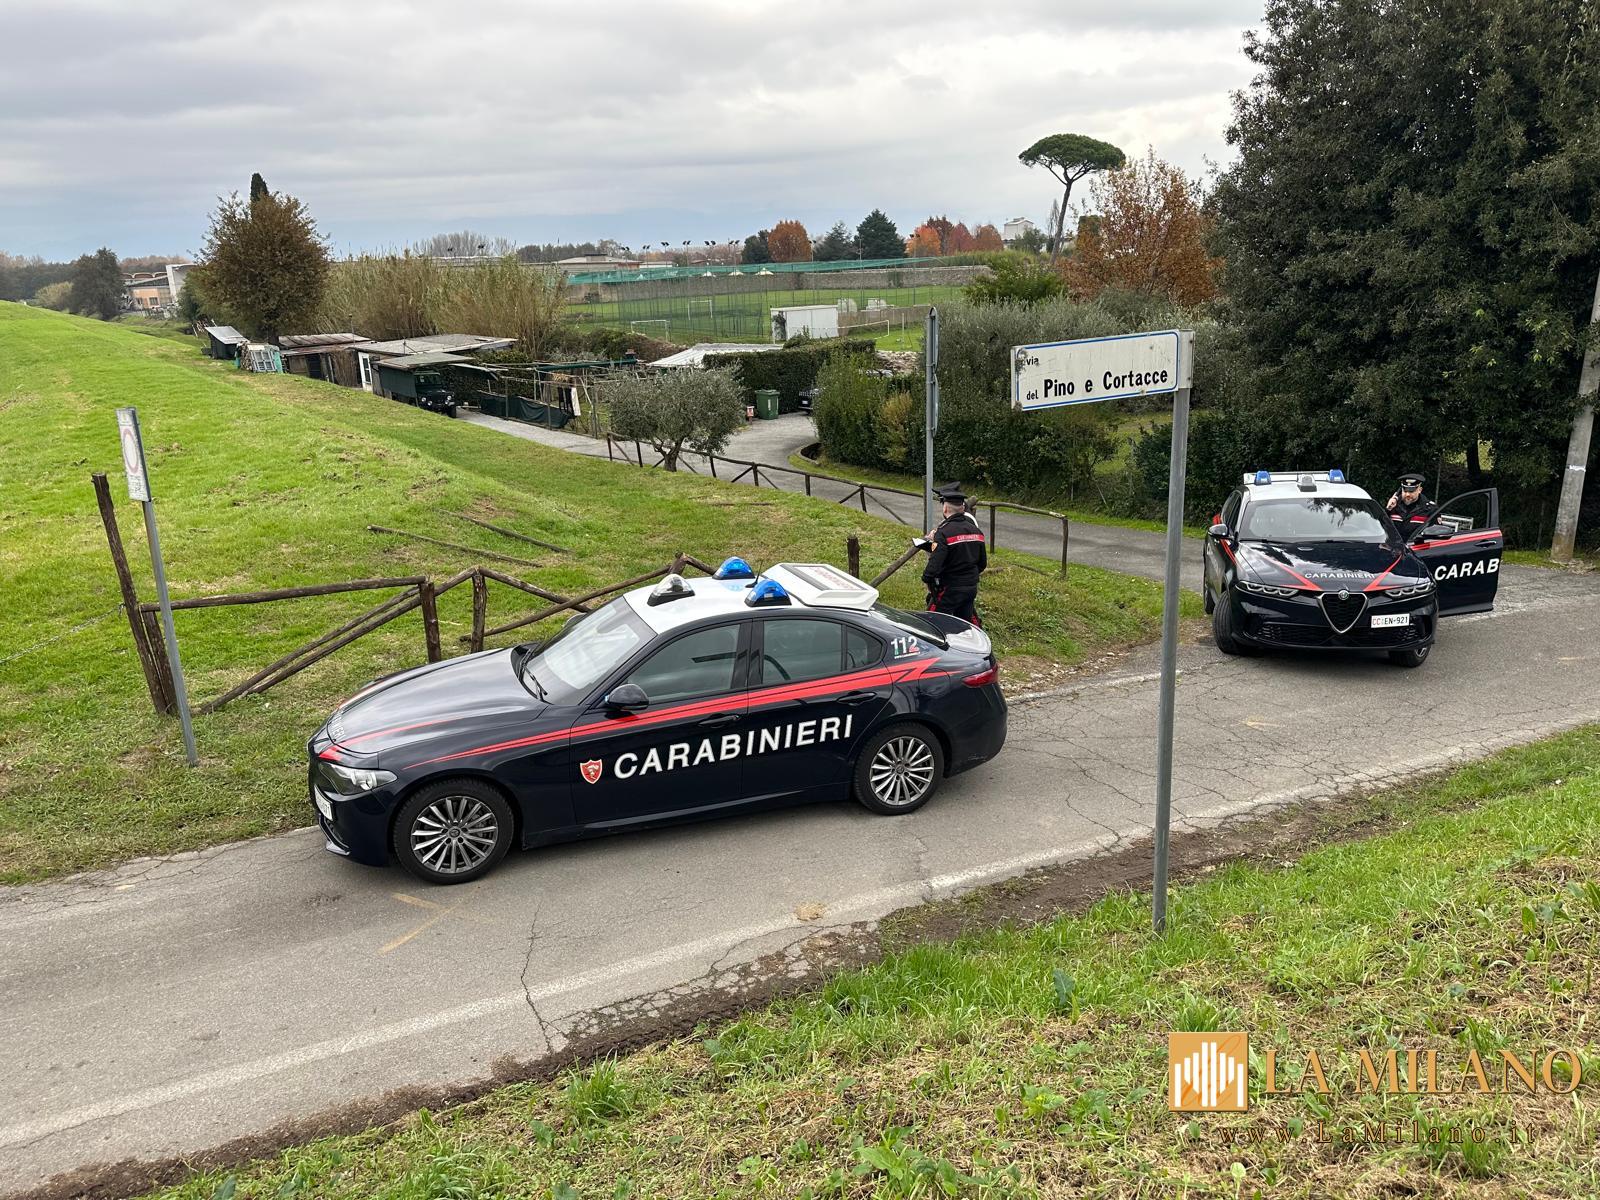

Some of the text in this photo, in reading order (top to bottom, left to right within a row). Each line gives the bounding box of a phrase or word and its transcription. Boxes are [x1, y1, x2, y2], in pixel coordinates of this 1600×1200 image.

[1026, 356, 1039, 366] via
[1026, 370, 1168, 400] del Pino e Cortacce
[1434, 558, 1500, 581] CARAB
[890, 636, 920, 655] 112
[613, 714, 853, 779] CARABINIERI
